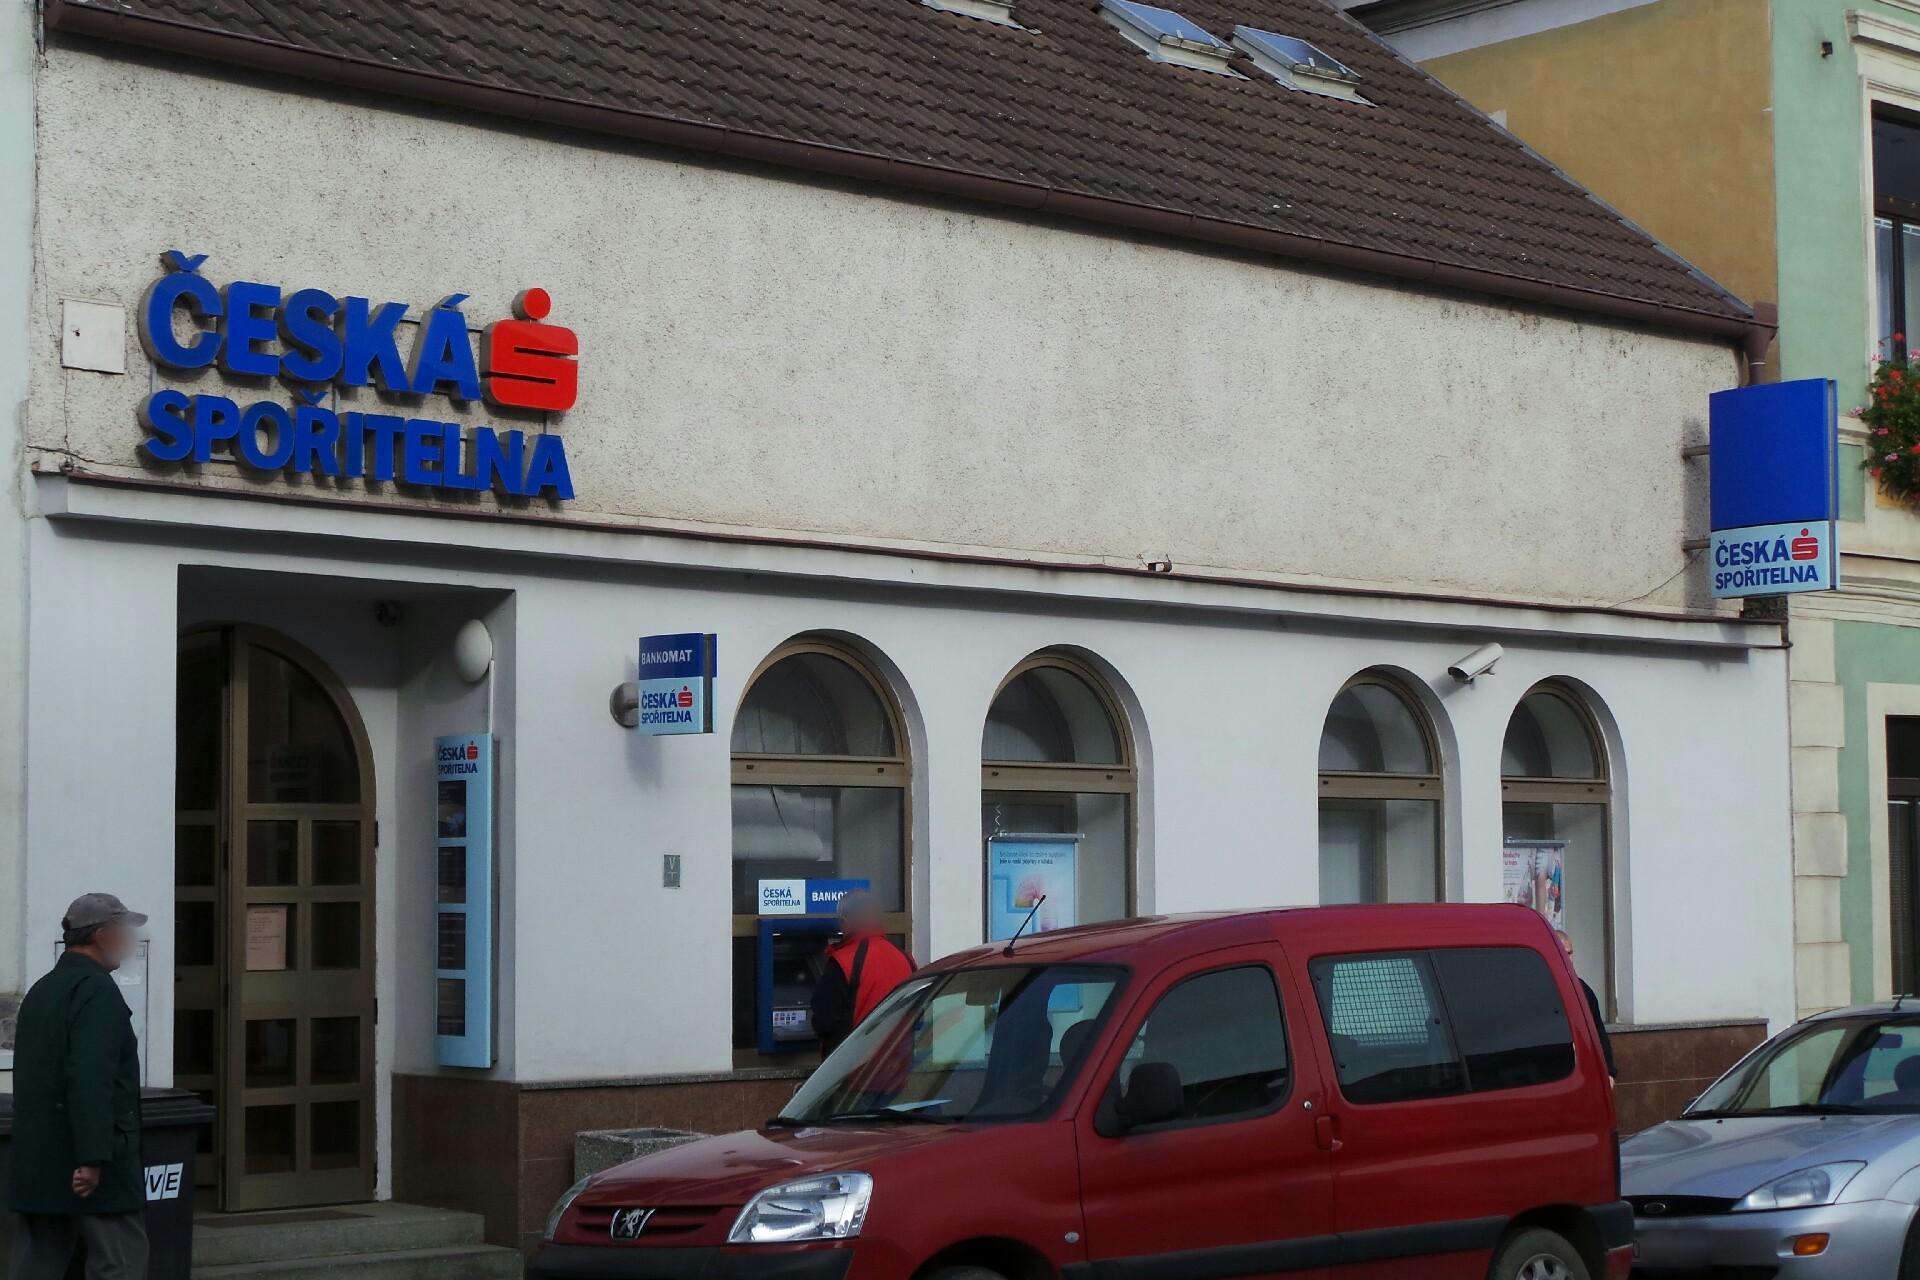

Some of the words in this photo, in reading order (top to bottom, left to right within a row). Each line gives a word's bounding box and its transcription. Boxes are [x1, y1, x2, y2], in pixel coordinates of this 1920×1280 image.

[140, 250, 482, 402] ČESKÁ
[138, 389, 575, 500] SPOŘITELNA
[1715, 535, 1790, 568] ČESKÁ
[1715, 565, 1819, 590] SPOŘITELNA
[641, 650, 692, 665] BANKOMAT
[641, 689, 678, 709] ČESKÁ
[641, 709, 692, 724] SPOŘITELNA
[763, 887, 792, 898] ČESKÁ
[763, 898, 801, 907] SPOŘITELNA
[811, 891, 848, 902] BANKO
[149, 1171, 180, 1194] VE
